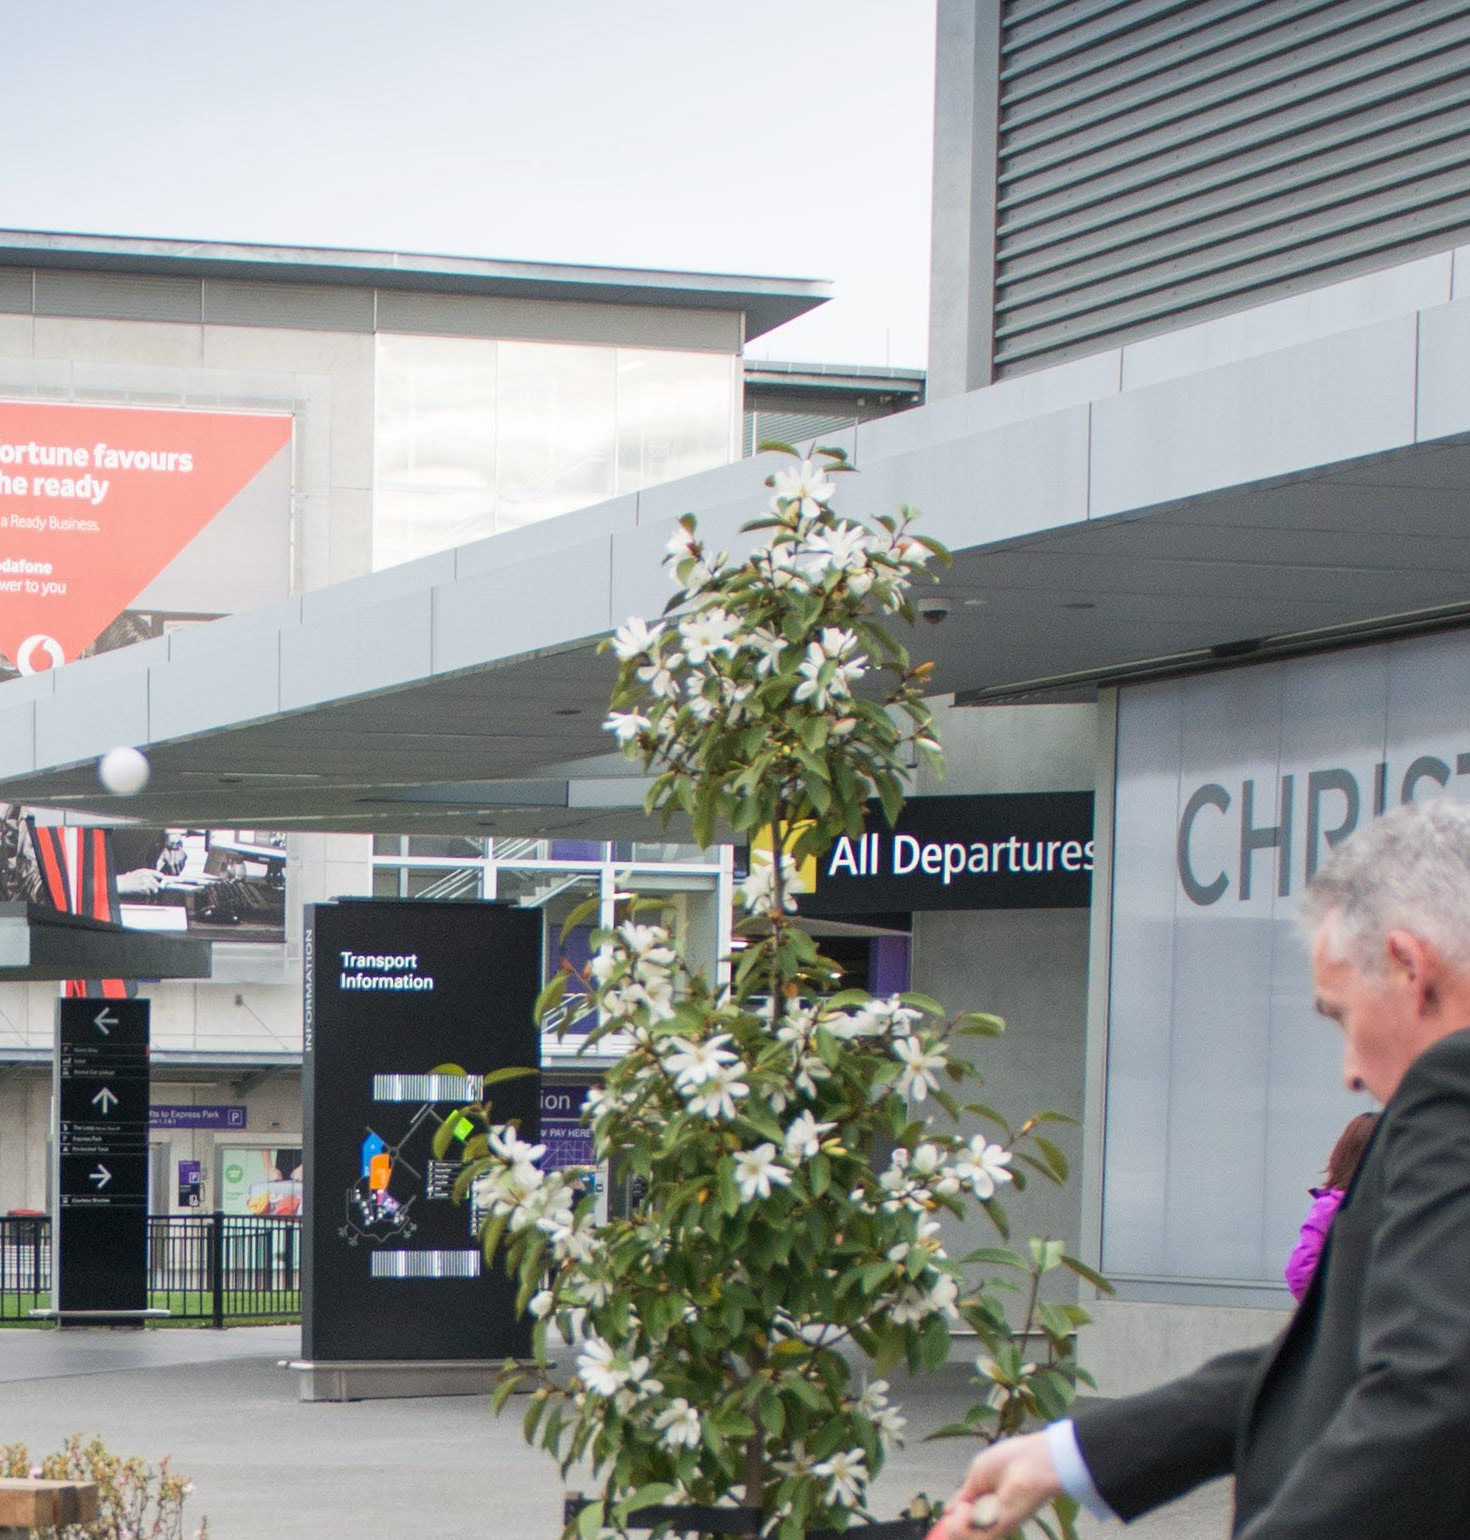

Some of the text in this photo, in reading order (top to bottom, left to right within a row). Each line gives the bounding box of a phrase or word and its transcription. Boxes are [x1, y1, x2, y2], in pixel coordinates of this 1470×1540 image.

[93, 443, 194, 473] favours
[33, 473, 110, 505] ready
[0, 517, 8, 528] a
[10, 514, 47, 532] Ready
[49, 516, 100, 532] Business.
[25, 580, 39, 593] to
[41, 582, 67, 597] you
[827, 833, 880, 876] All
[340, 951, 417, 971] Transport
[305, 928, 313, 1052] INFORMATION
[340, 973, 434, 990] Information
[171, 1110, 201, 1120] Express
[202, 1110, 219, 1119] Park
[550, 1128, 591, 1138] PAY HERE
